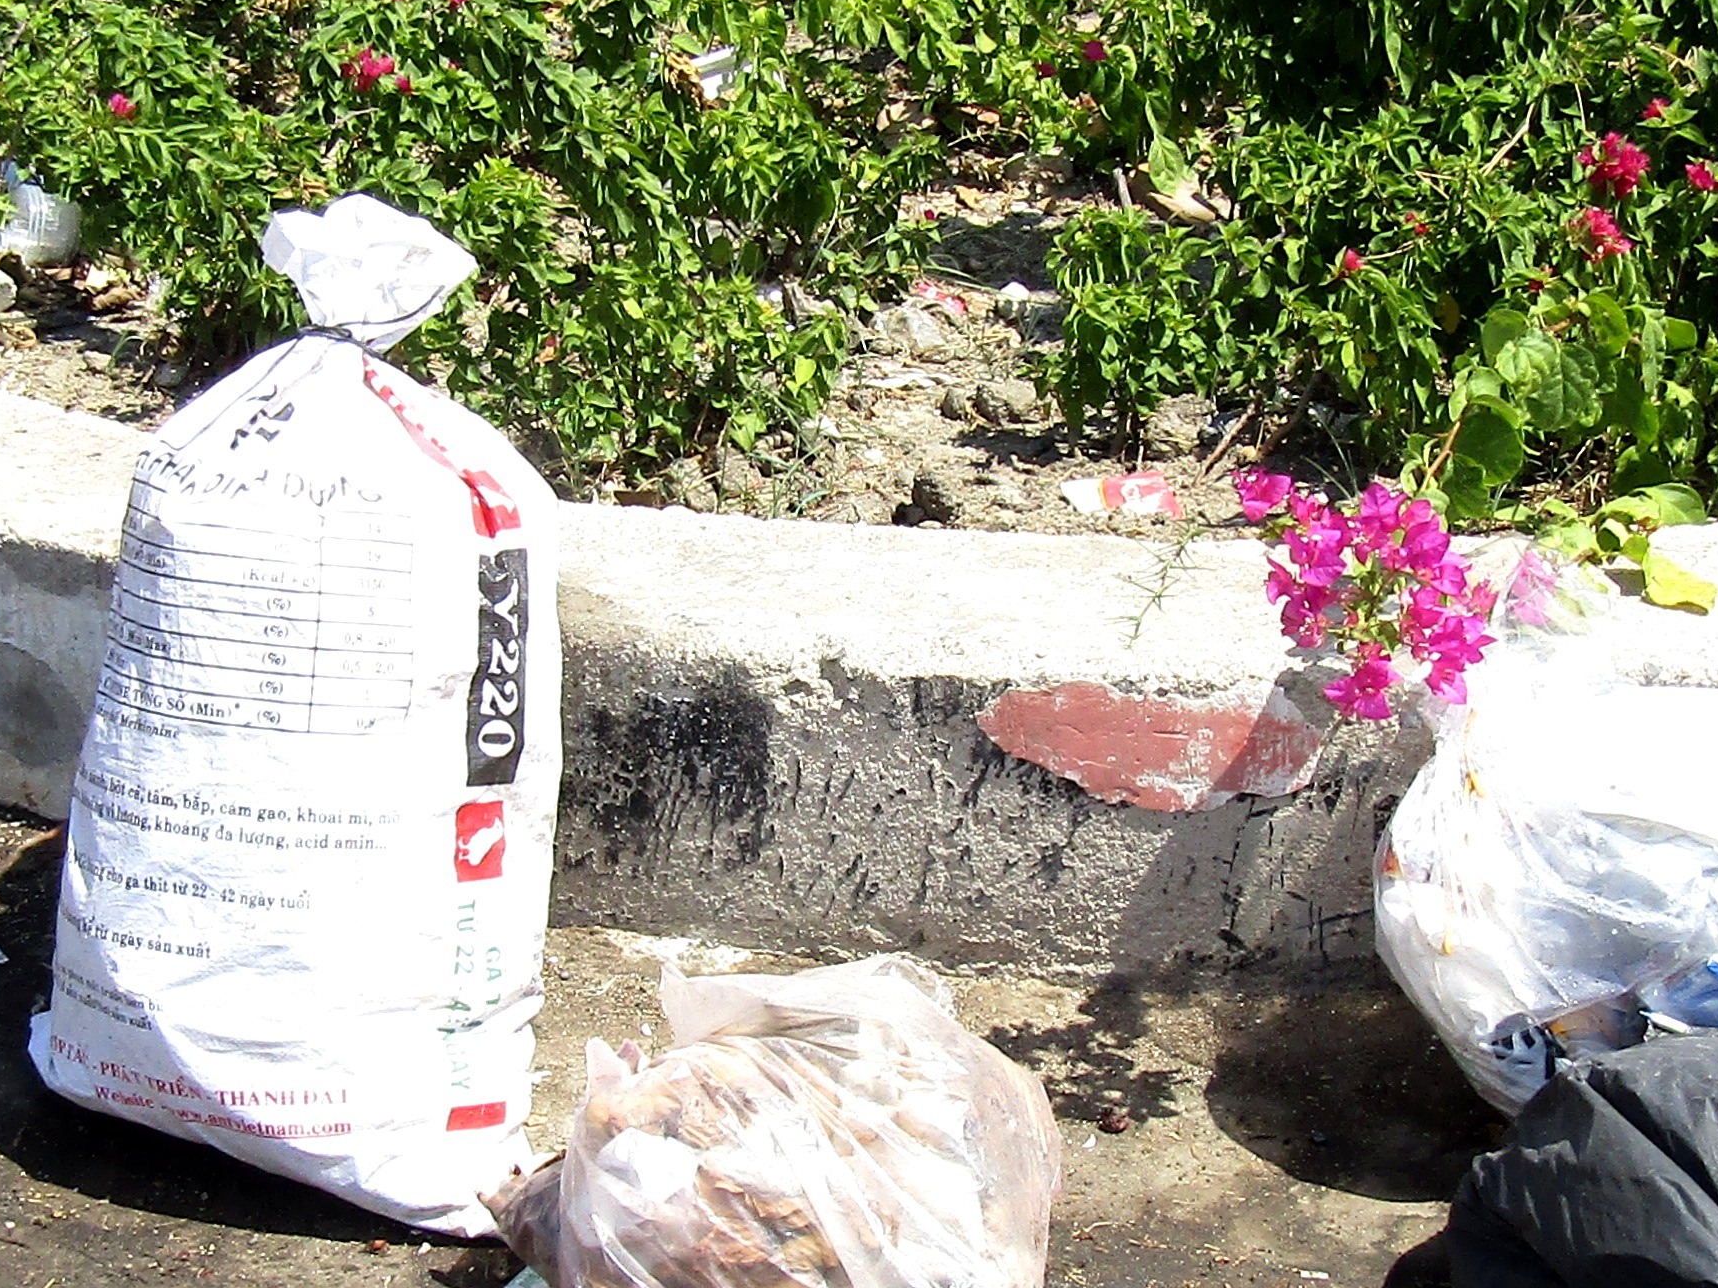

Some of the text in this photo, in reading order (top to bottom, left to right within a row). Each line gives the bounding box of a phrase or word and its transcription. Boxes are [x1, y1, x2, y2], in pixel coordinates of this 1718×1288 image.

[297, 806, 343, 824] khoai
[155, 815, 210, 842] khoáng
[215, 824, 233, 842] đa
[238, 827, 290, 851] lượng,
[294, 834, 329, 850] acid
[125, 872, 140, 890] gà
[192, 882, 208, 899] 22
[219, 888, 236, 903] 42
[239, 890, 276, 911] ngày
[111, 929, 144, 951] ngày
[147, 934, 172, 954] sản
[175, 941, 211, 959] xuất
